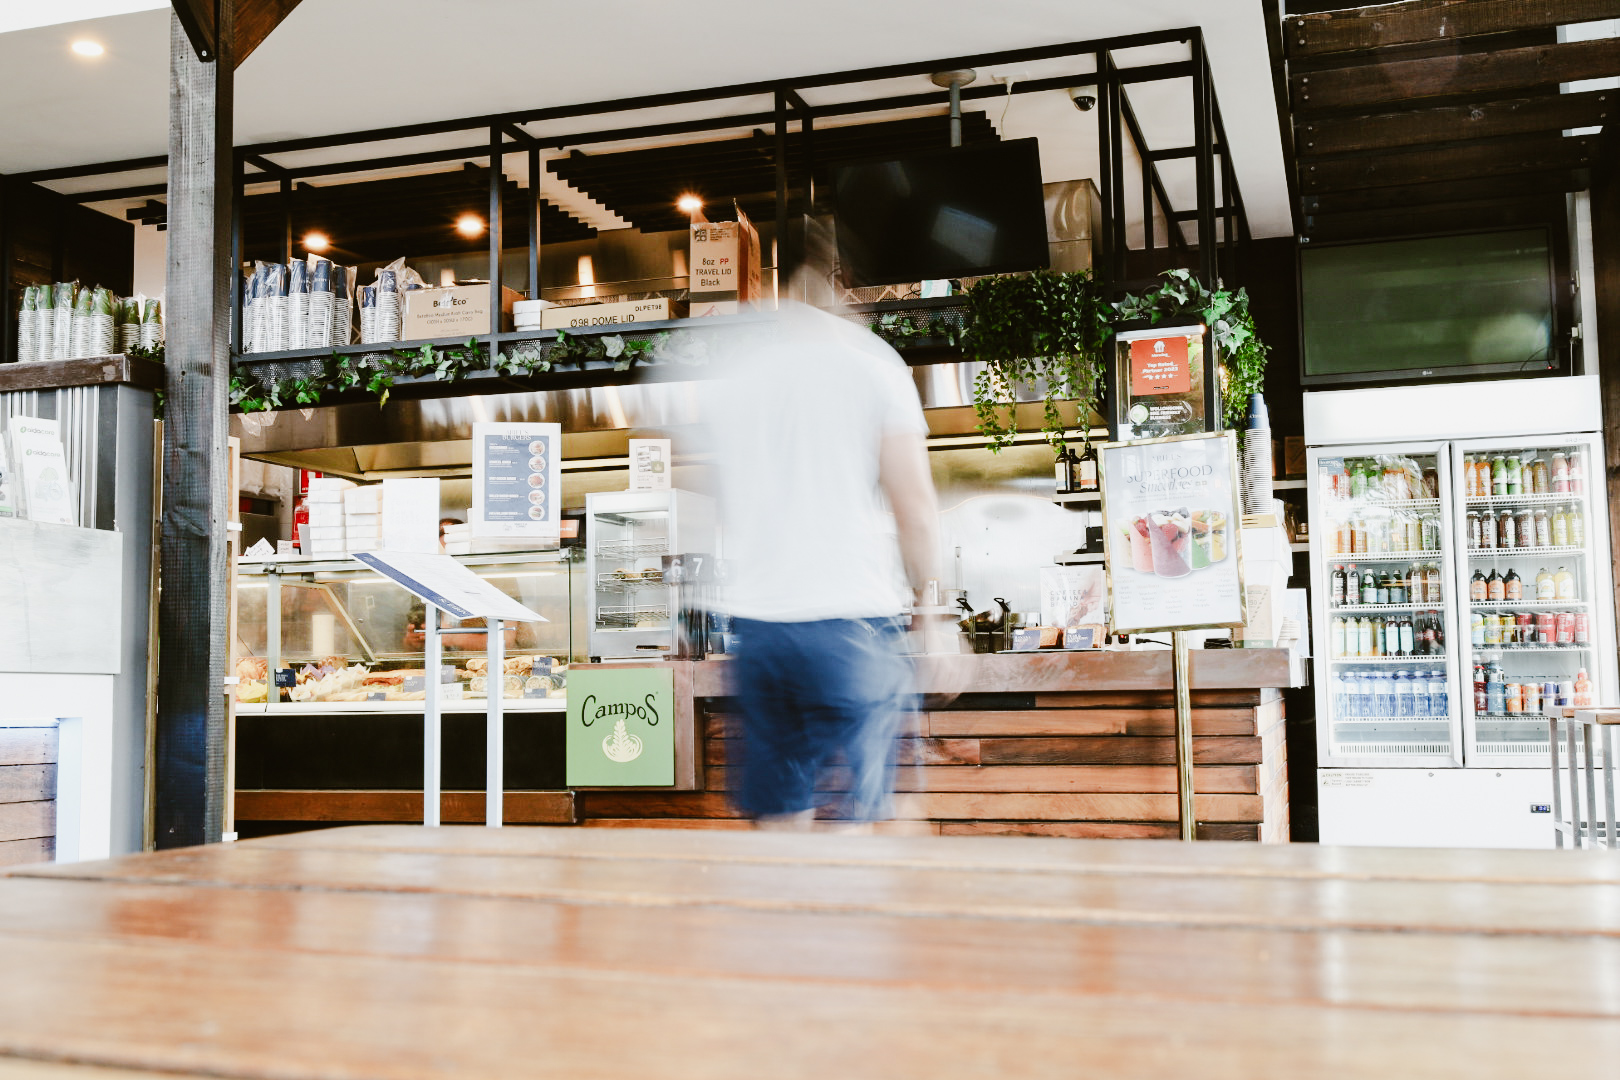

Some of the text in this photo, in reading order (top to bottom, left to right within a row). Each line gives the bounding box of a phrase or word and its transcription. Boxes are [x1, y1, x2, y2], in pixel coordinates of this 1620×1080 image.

[702, 257, 730, 266] 8oz PP
[695, 268, 720, 276] TRAVEL
[700, 278, 720, 287] Black
[591, 315, 618, 326] DOME
[620, 313, 635, 323] LID
[1126, 464, 1213, 484] SUPERFOOD
[692, 557, 703, 577] 7
